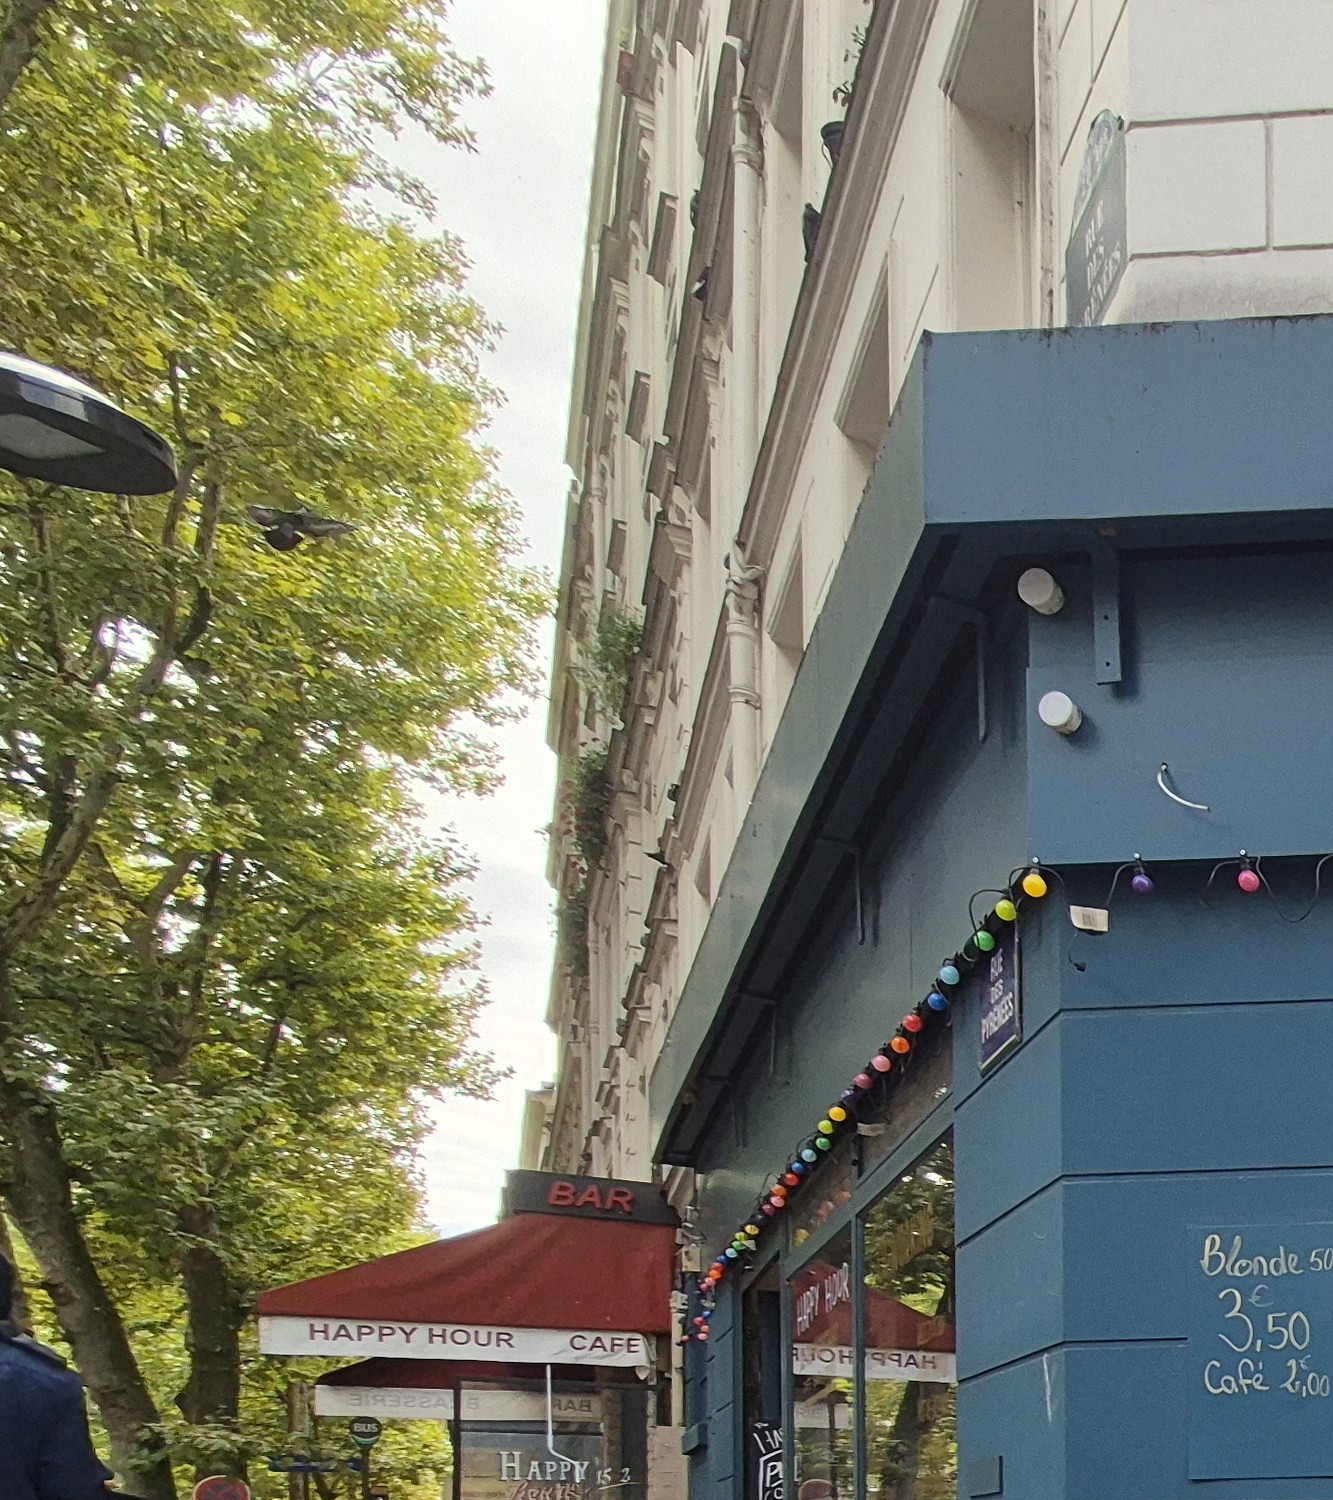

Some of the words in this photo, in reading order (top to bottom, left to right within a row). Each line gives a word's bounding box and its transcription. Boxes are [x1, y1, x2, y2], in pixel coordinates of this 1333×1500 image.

[549, 1181, 635, 1213] BAR
[1199, 1233, 1304, 1277] Blonde
[309, 1322, 418, 1345] HAPPY
[427, 1327, 516, 1349] HOUR
[568, 1334, 641, 1354] CAFE
[1203, 1357, 1270, 1395] Café
[353, 1422, 379, 1434] BUS
[500, 1451, 591, 1482] HAPPY
